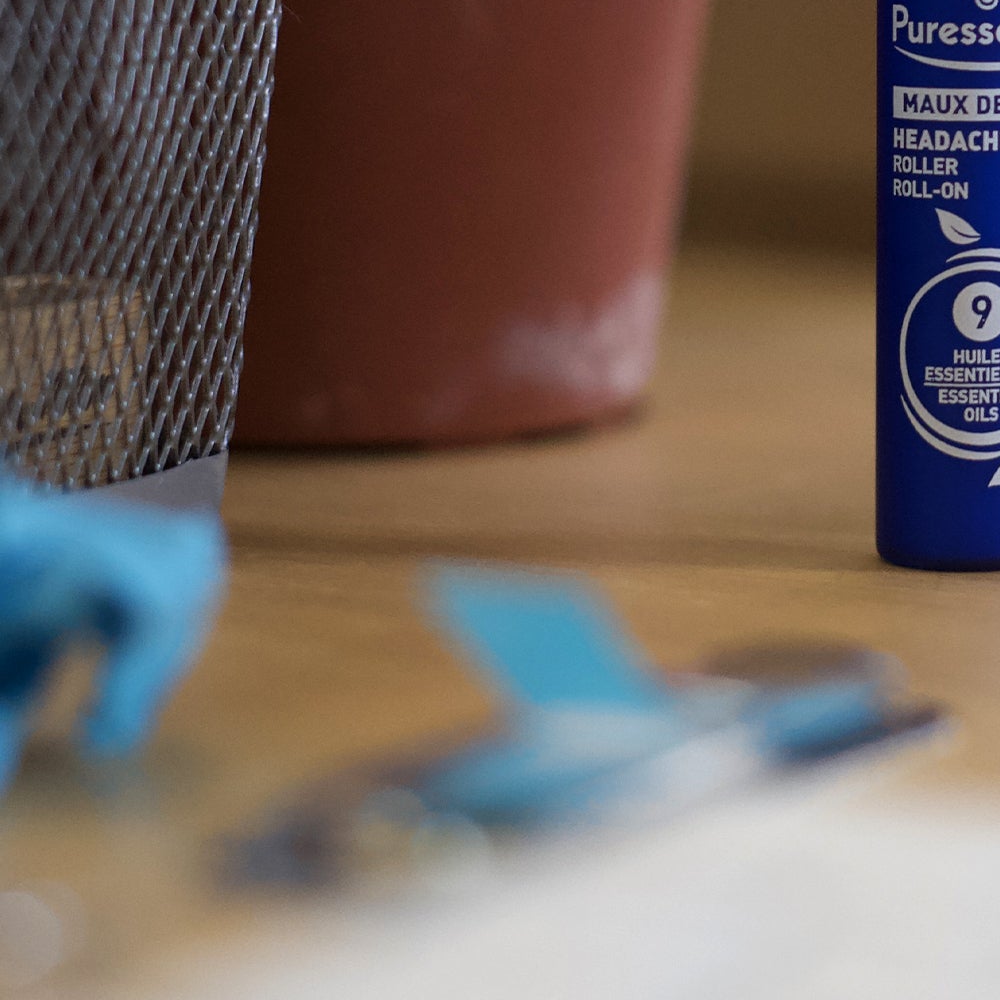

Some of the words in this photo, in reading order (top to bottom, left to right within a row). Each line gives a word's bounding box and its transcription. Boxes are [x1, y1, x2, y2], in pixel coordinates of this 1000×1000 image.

[903, 93, 968, 114] MAUX
[893, 154, 958, 175] ROLLER
[893, 178, 969, 199] ROLL-ON
[971, 295, 992, 329] 9
[963, 407, 999, 422] OILS
